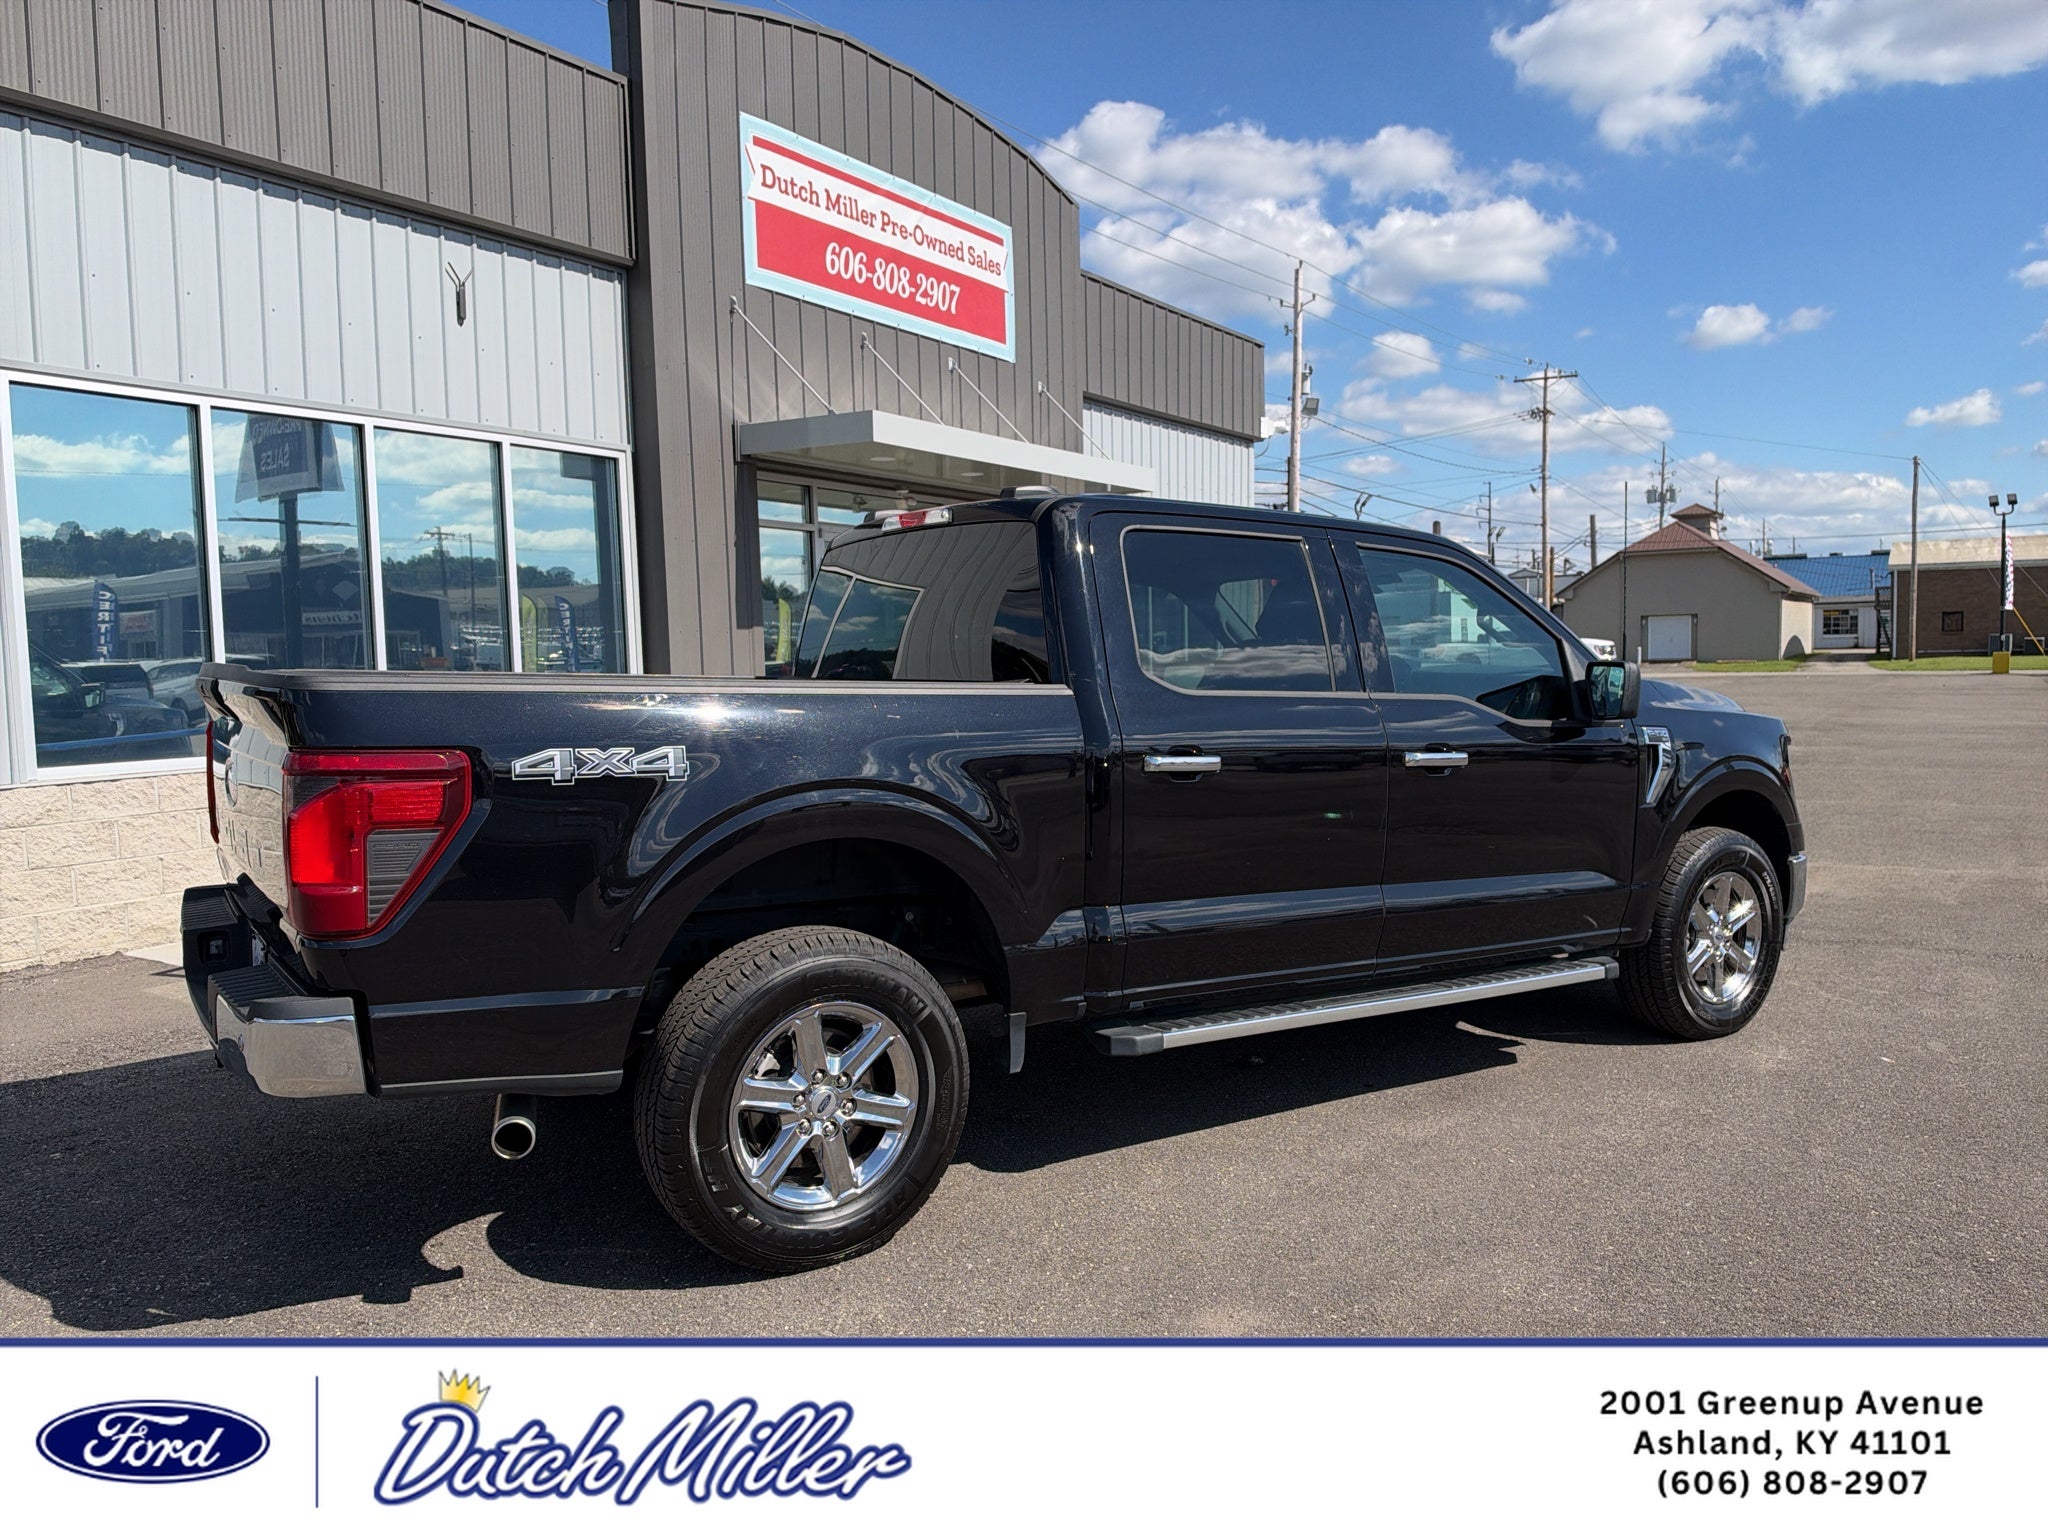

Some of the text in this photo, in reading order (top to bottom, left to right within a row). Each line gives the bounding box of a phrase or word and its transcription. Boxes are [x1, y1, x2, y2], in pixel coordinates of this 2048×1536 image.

[760, 163, 1001, 276] Dutch Miller Pre-Owned Sales
[825, 242, 961, 314] 606-808-2907
